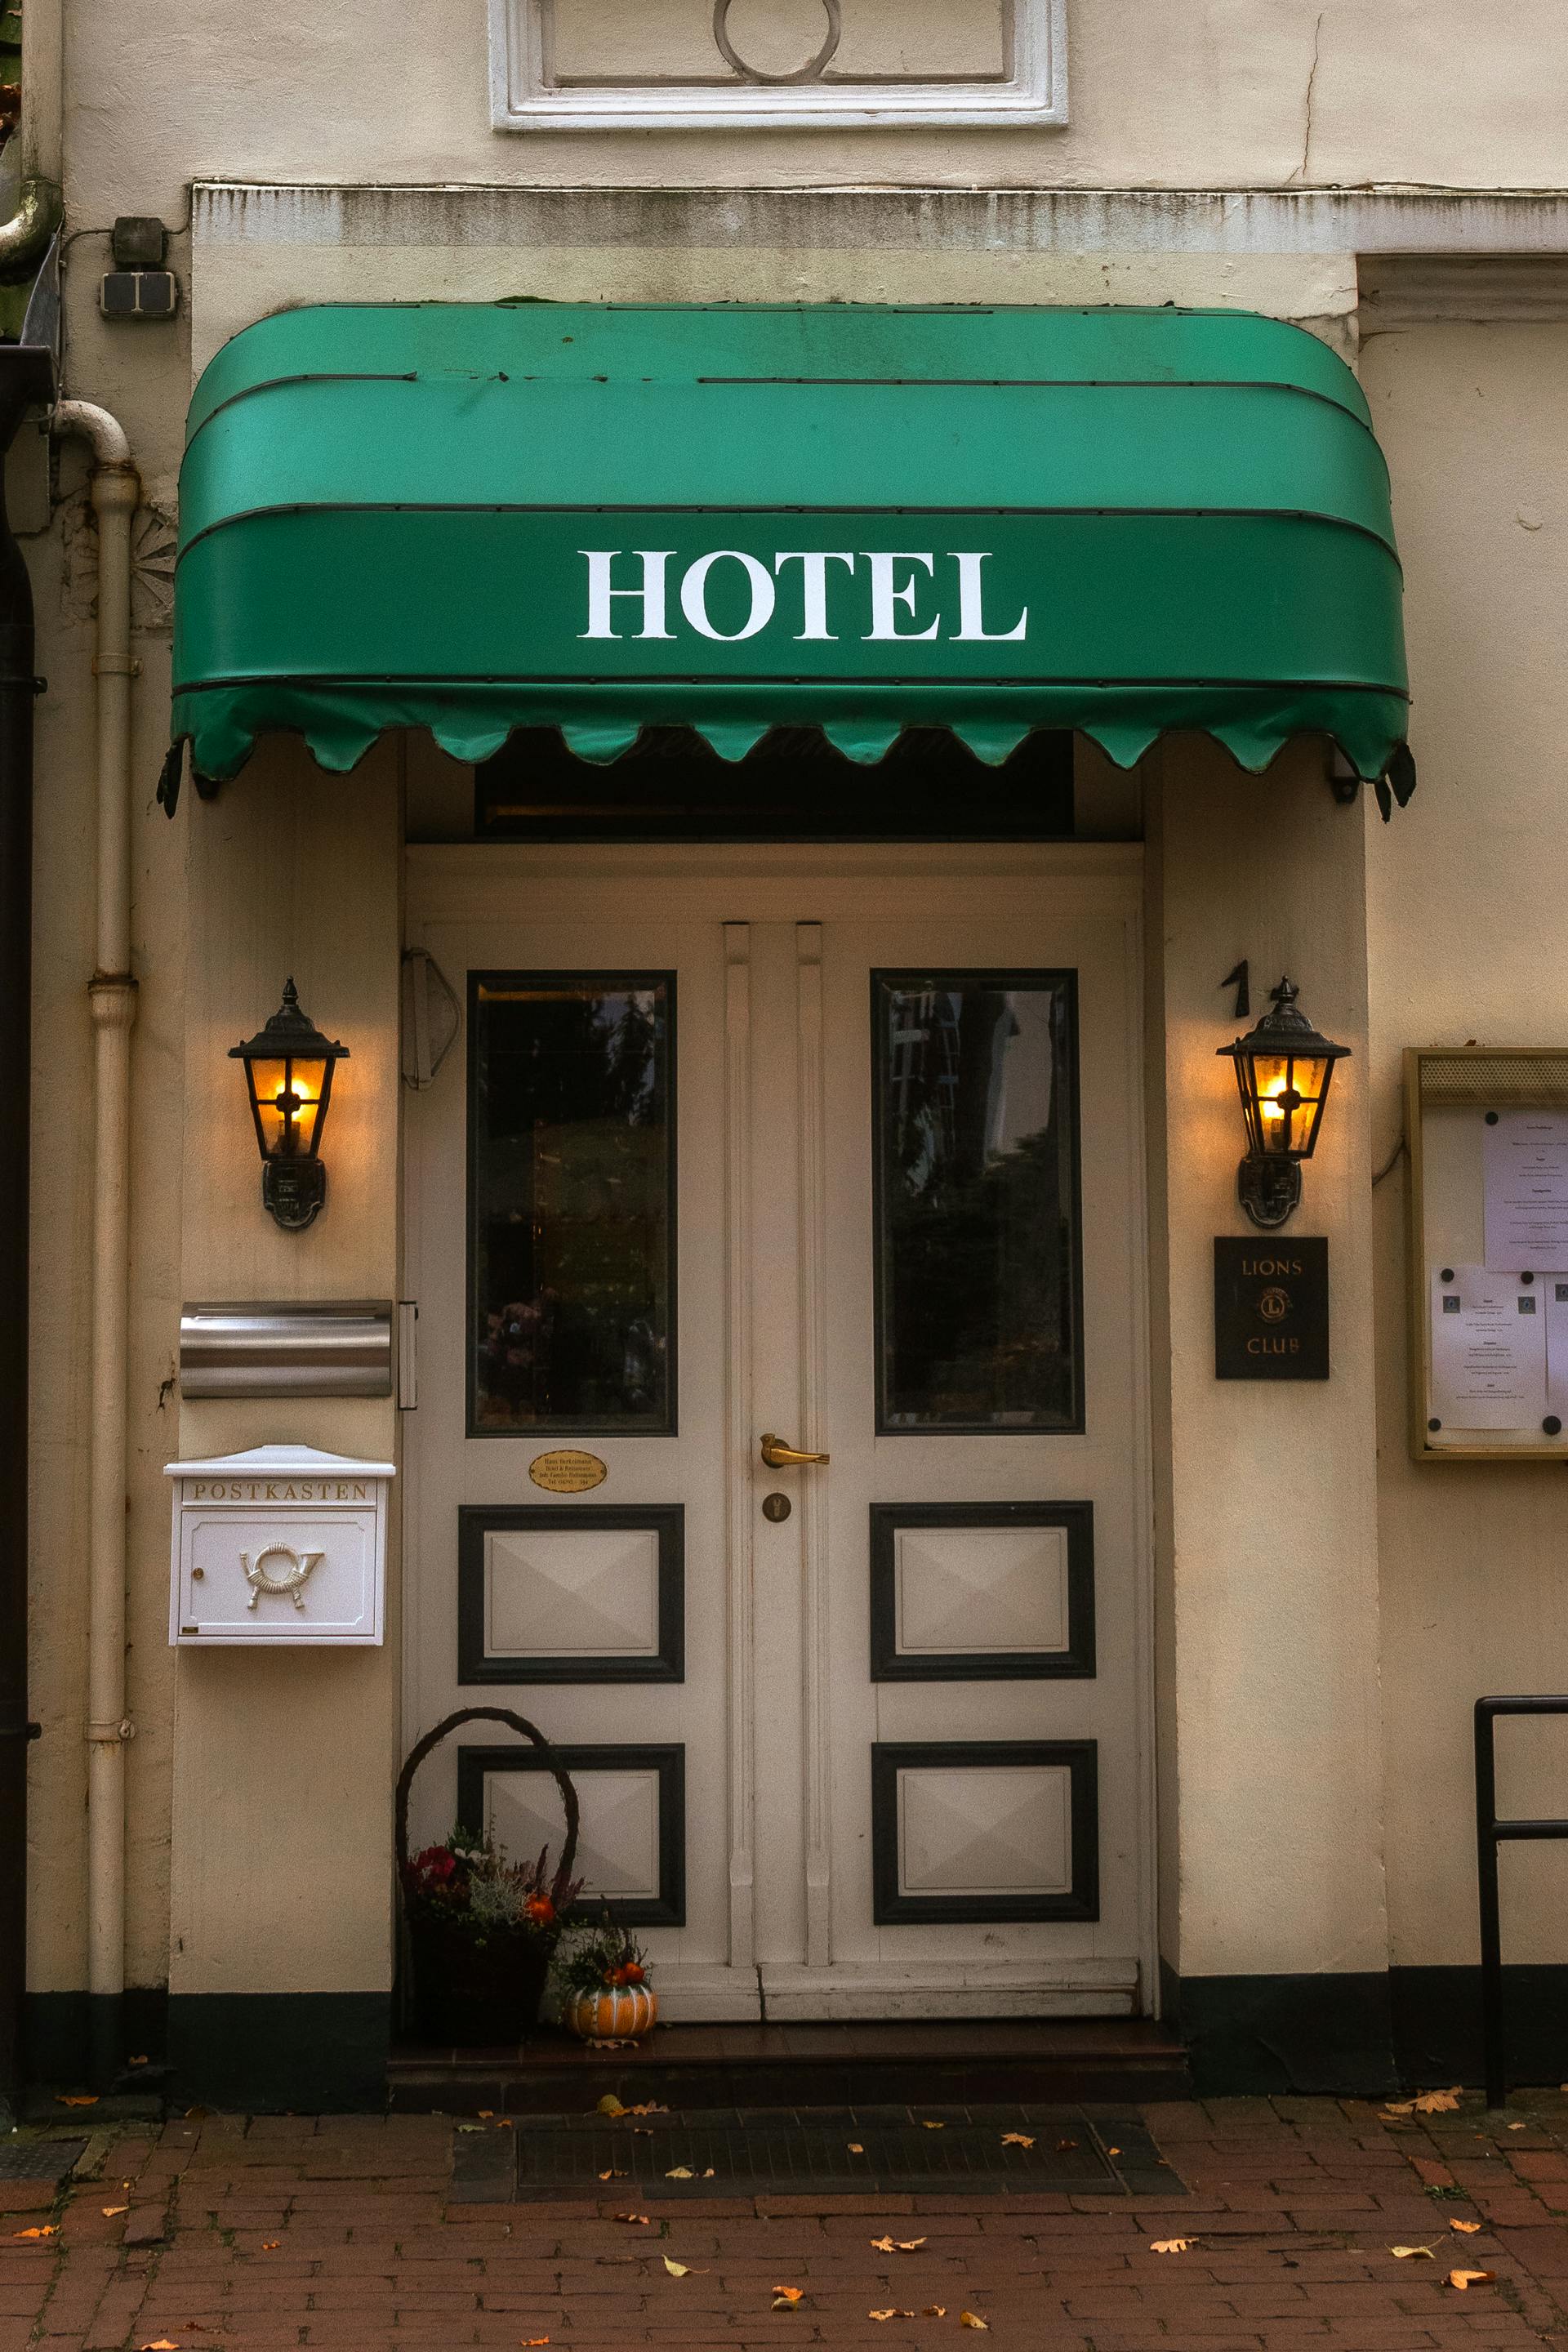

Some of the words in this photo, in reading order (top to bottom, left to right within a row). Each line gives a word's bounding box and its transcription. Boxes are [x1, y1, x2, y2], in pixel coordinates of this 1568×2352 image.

[577, 550, 1028, 641] HOTEL
[1242, 1259, 1302, 1276] LIONS
[1247, 1338, 1300, 1354] CLUB
[194, 1483, 368, 1499] POSTKASTEN
